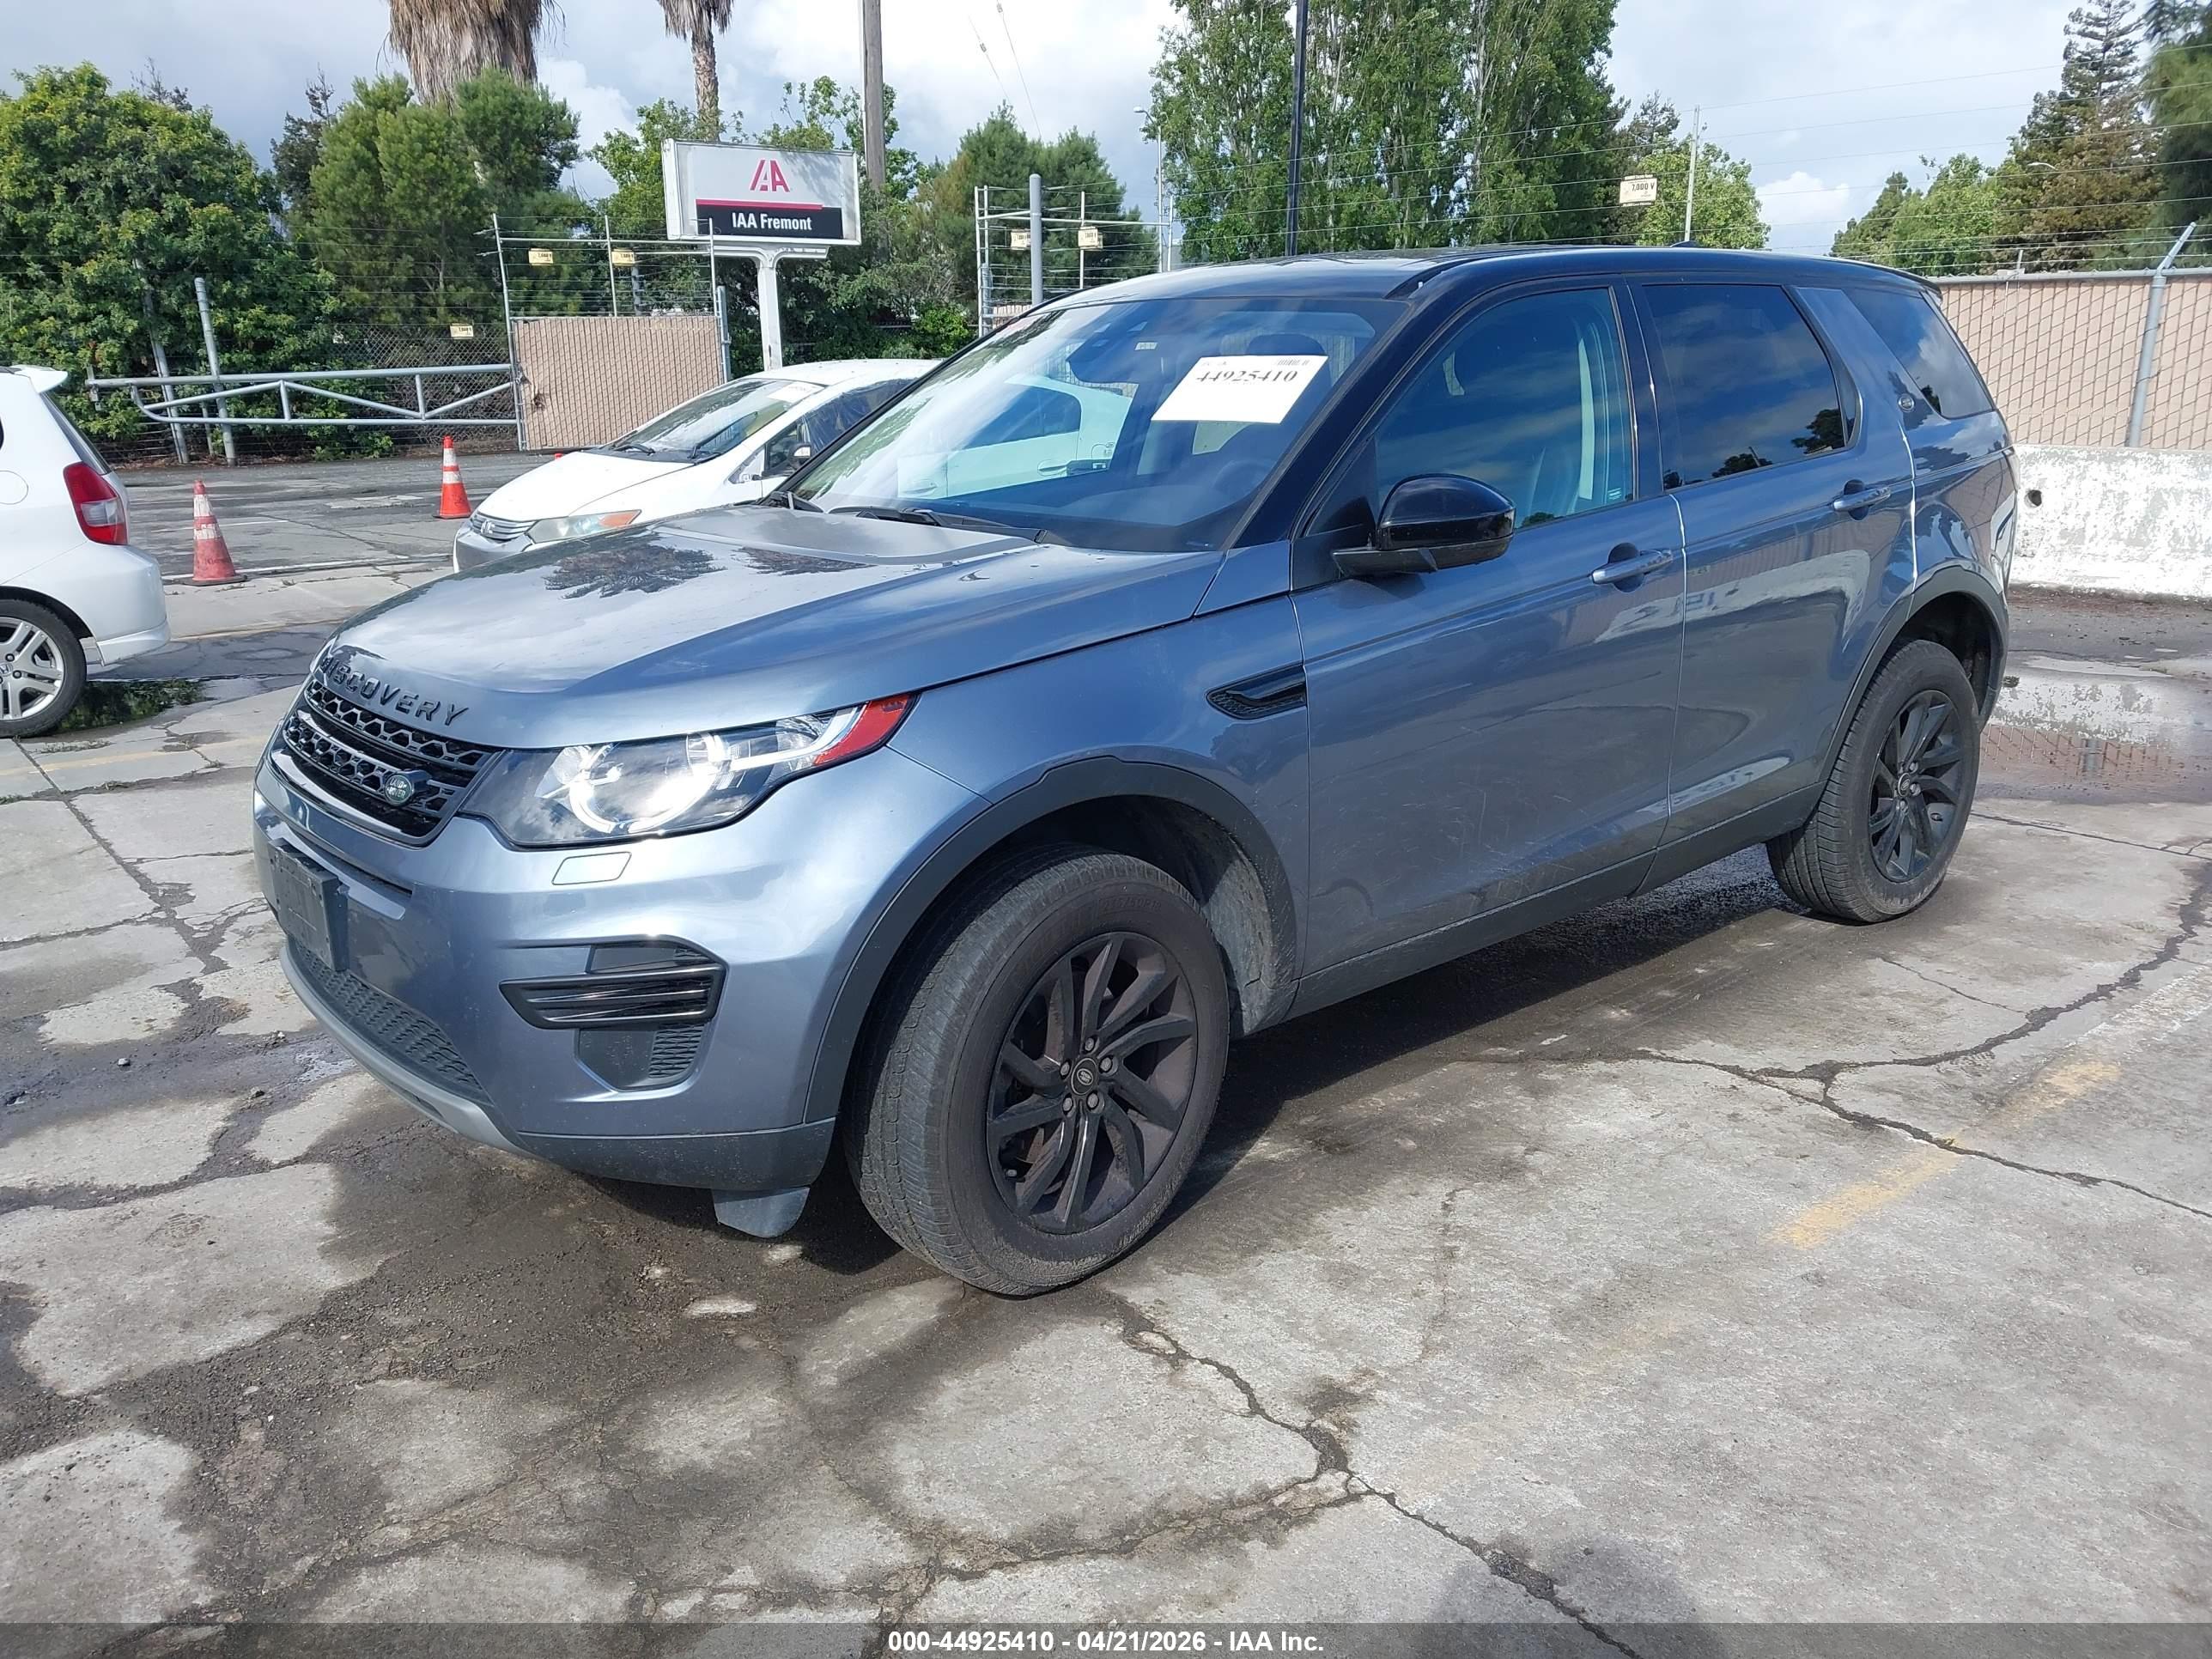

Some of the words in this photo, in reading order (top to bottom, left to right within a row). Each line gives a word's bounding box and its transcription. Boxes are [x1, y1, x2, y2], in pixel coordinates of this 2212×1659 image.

[732, 212, 757, 228] IAA
[760, 214, 811, 230] Fremont
[1196, 370, 1297, 382] 44925410
[321, 658, 469, 726] DISCOVERY
